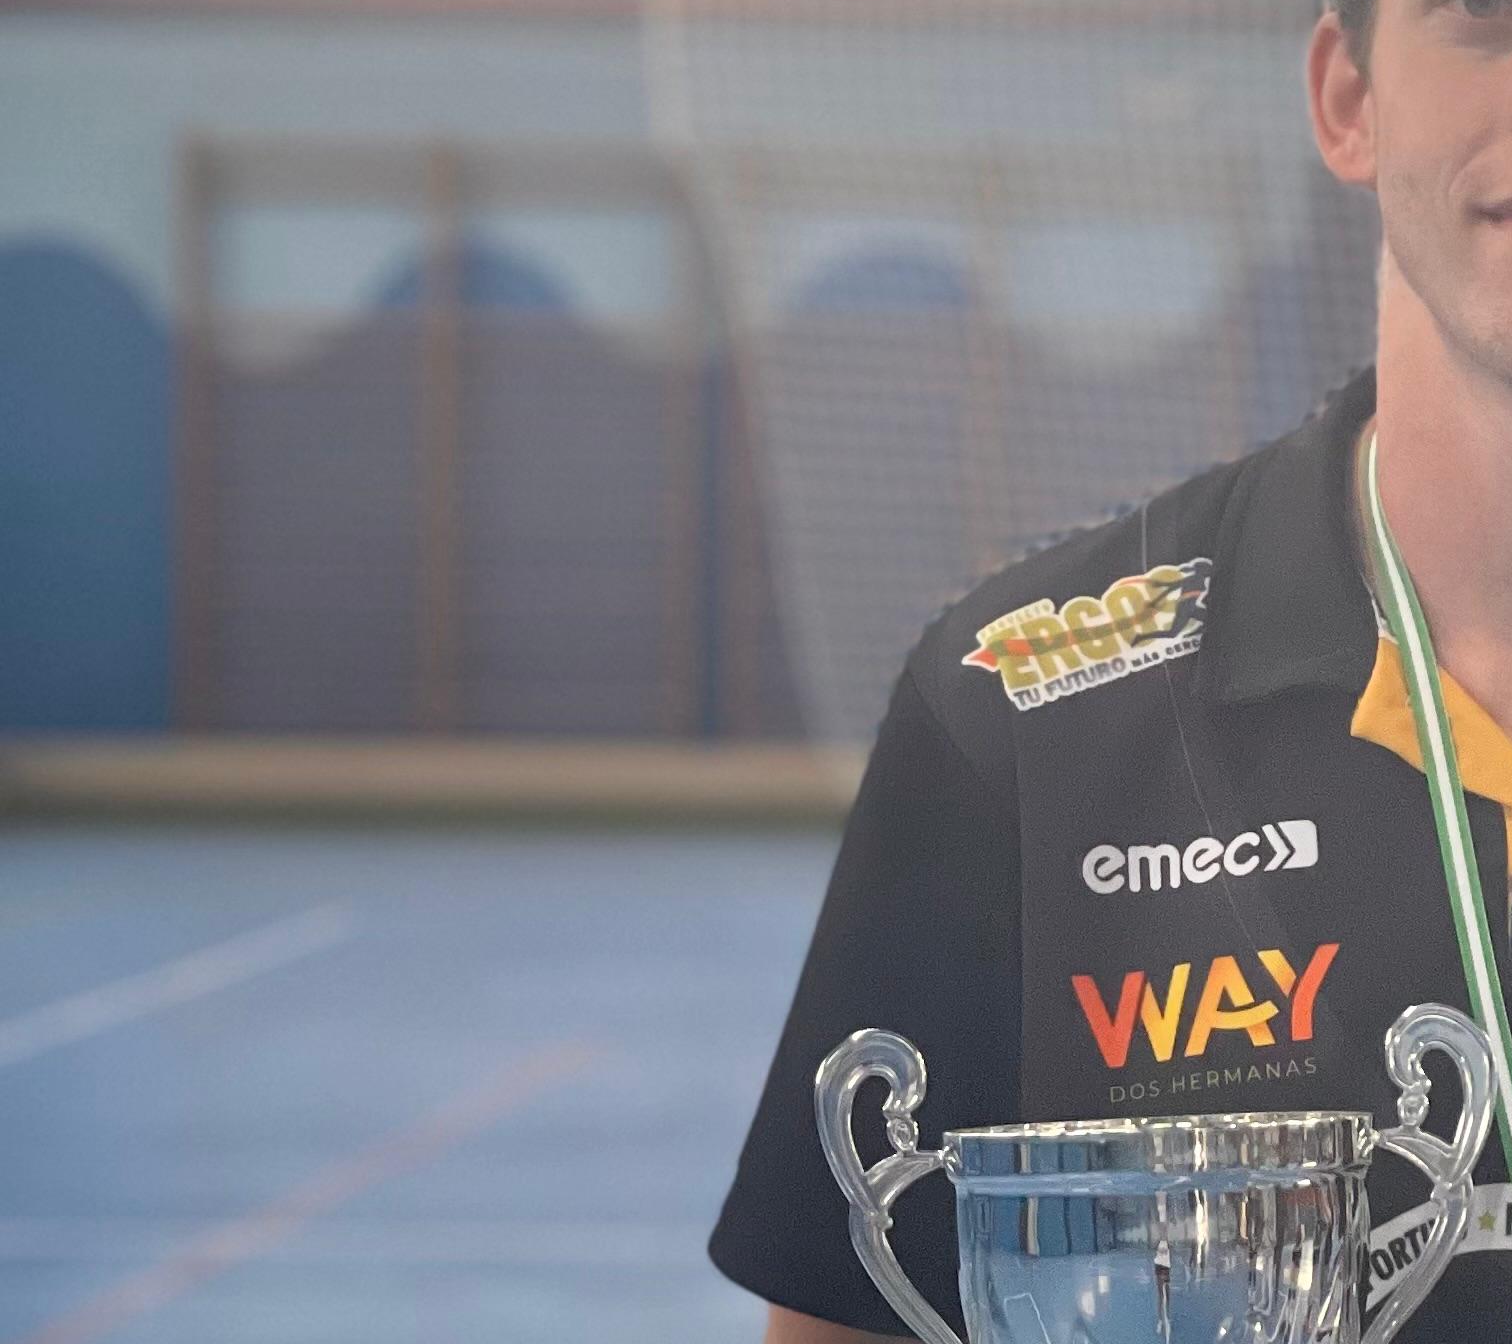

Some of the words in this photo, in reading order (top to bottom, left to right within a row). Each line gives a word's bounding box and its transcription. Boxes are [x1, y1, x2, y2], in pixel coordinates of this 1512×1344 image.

[1013, 688, 1042, 708] TU
[1045, 657, 1127, 697] FUTURO
[1082, 831, 1262, 894] emec
[1071, 943, 1340, 1068] WAY
[1109, 1080, 1161, 1103] DOS
[1172, 1057, 1318, 1094] HERMANAS
